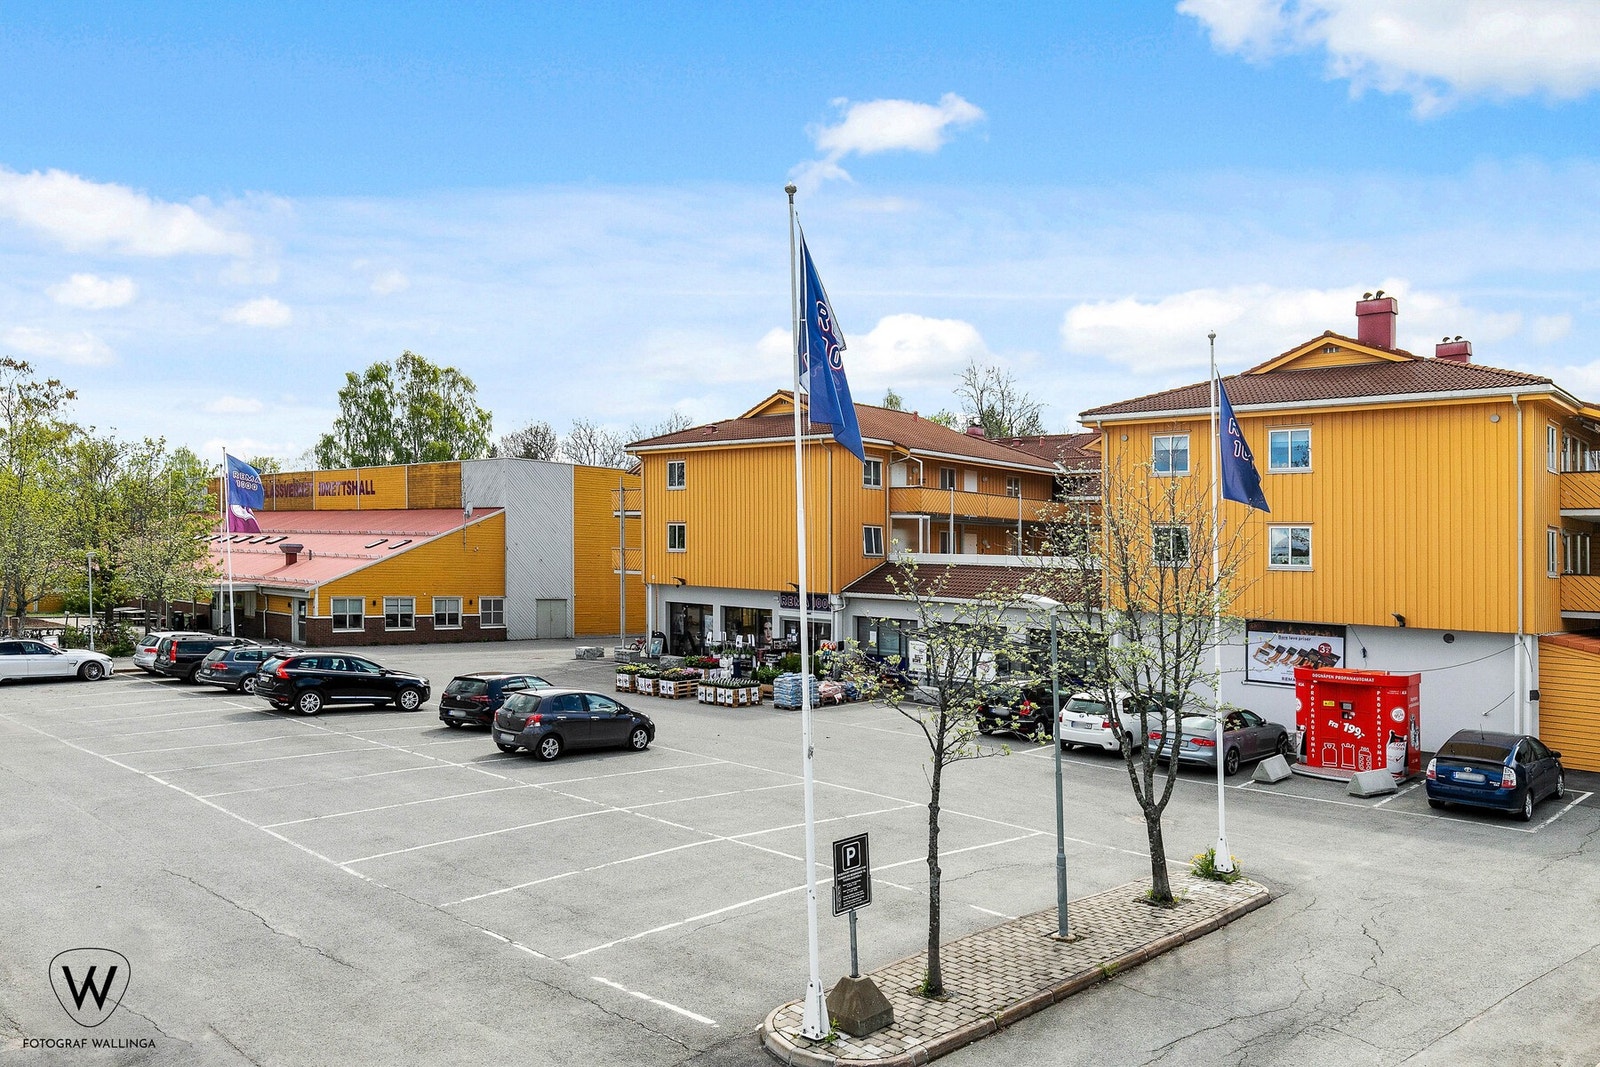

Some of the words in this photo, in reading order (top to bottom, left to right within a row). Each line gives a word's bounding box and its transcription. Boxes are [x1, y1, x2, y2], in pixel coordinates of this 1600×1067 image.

[232, 471, 260, 484] REMA
[236, 480, 258, 491] 1000
[318, 480, 376, 497] IDRETTSHALL
[1328, 720, 1339, 729] Fra
[846, 846, 856, 867] P
